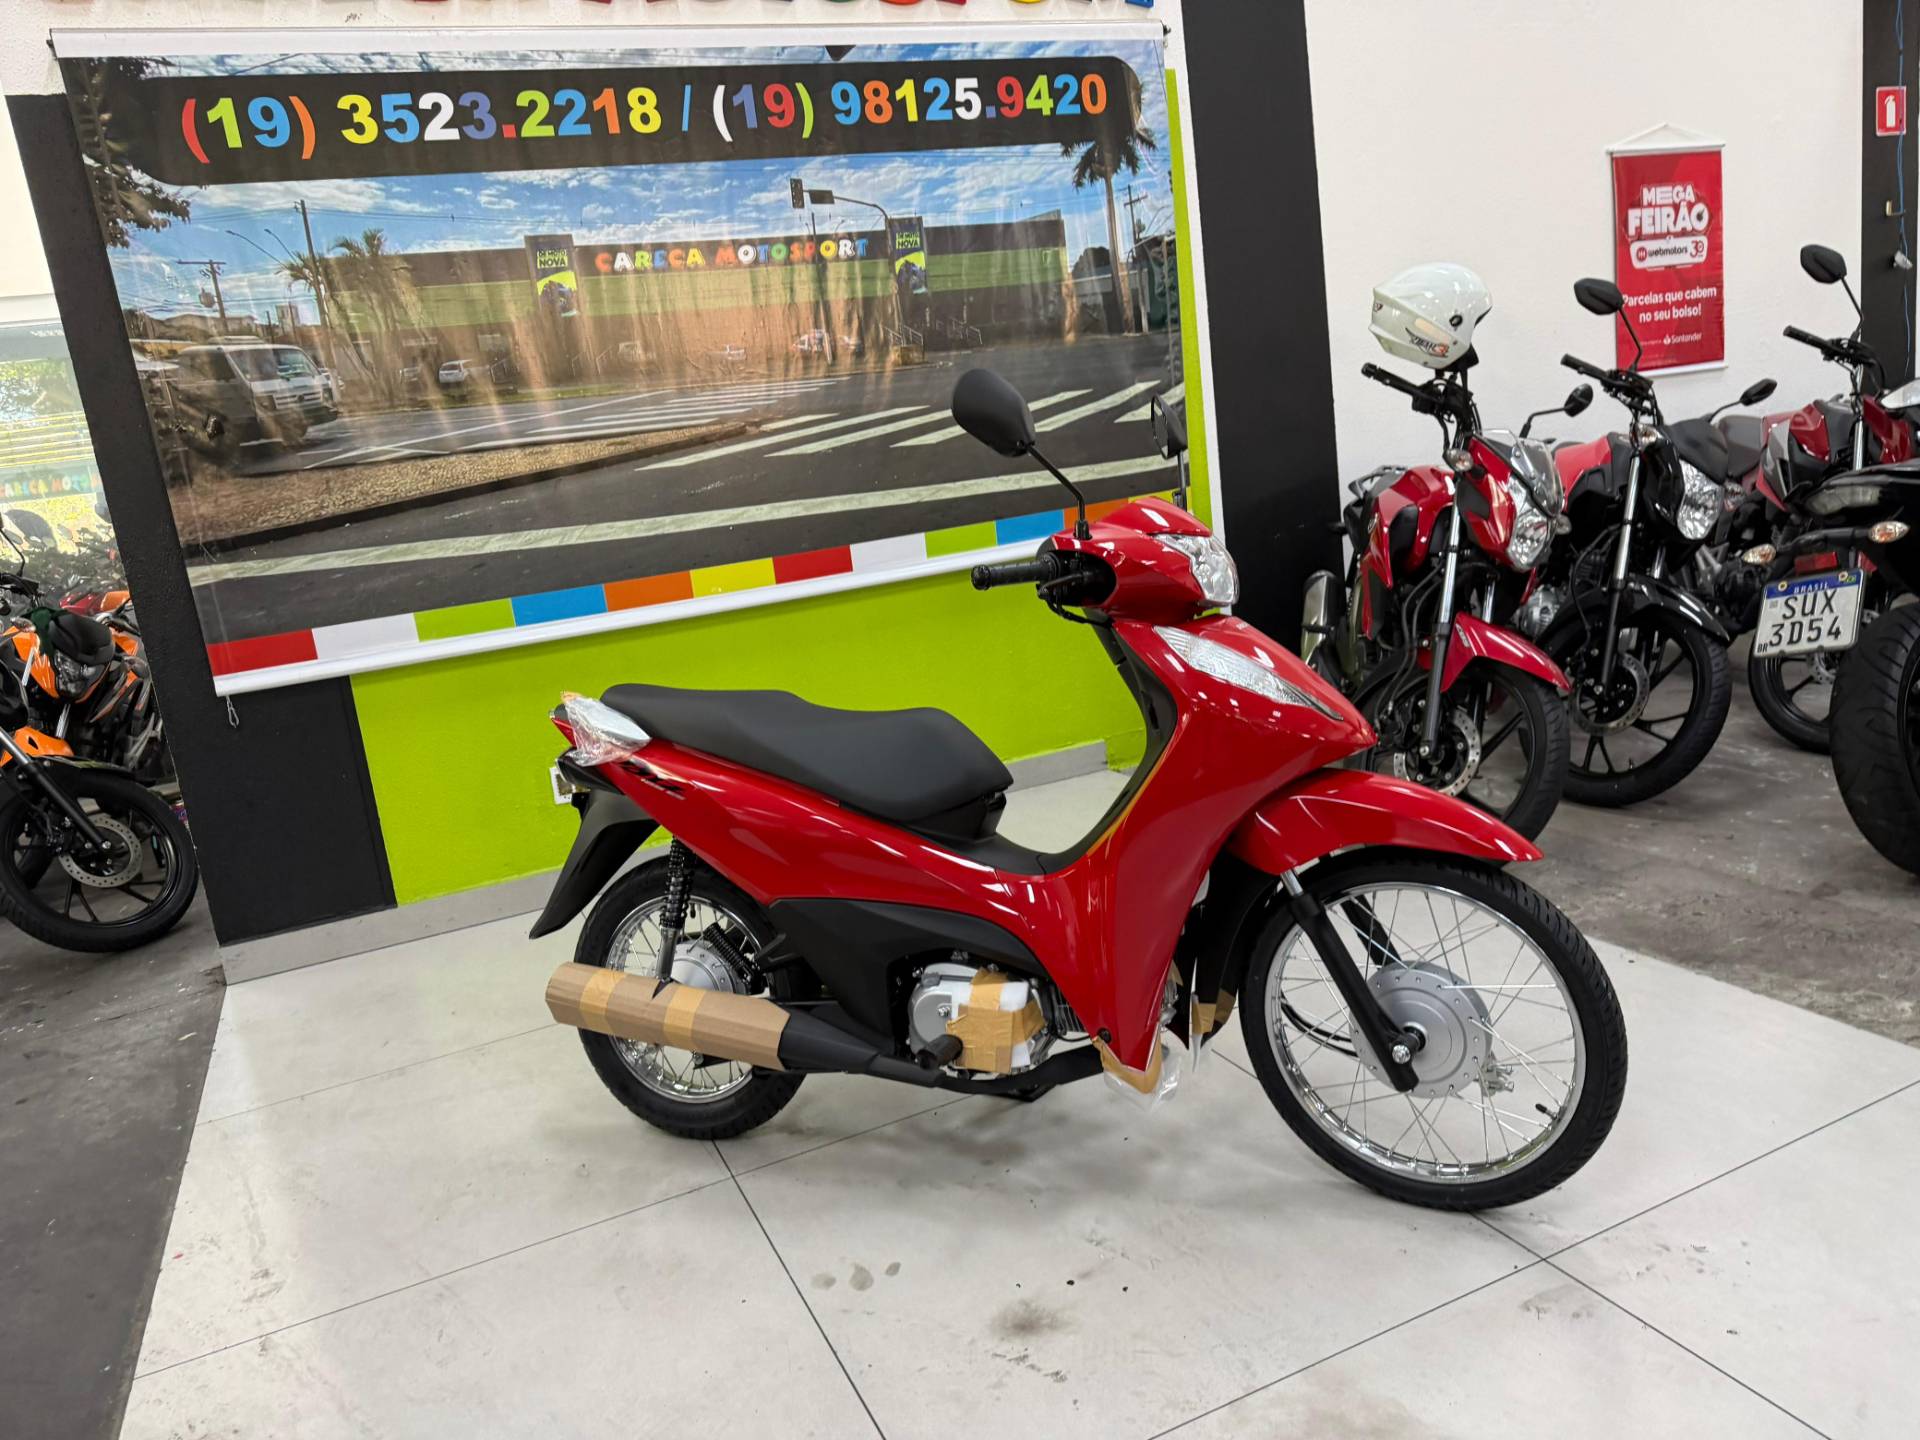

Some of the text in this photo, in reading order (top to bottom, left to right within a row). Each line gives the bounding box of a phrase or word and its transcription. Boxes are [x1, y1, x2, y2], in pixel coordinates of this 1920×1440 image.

[182, 96, 316, 164] (19)
[336, 87, 662, 145] 3523.2218
[712, 82, 814, 142] (19)
[831, 73, 1107, 125] 98125.9420
[1642, 184, 1695, 206] MEGA
[1628, 201, 1709, 237] FEIRÃO
[897, 239, 919, 249] NOVA
[1648, 245, 1688, 258] webmotors
[539, 257, 566, 267] NOVA
[594, 238, 869, 273] CARECA MOTOSPORT
[1622, 285, 1717, 308] Parcelas que cabem
[1639, 303, 1702, 323] no seu bolso!
[1671, 332, 1702, 344] Santander
[1794, 582, 1829, 594] BRASIL
[1782, 589, 1837, 620] SUX
[1769, 616, 1842, 647] 3D54
